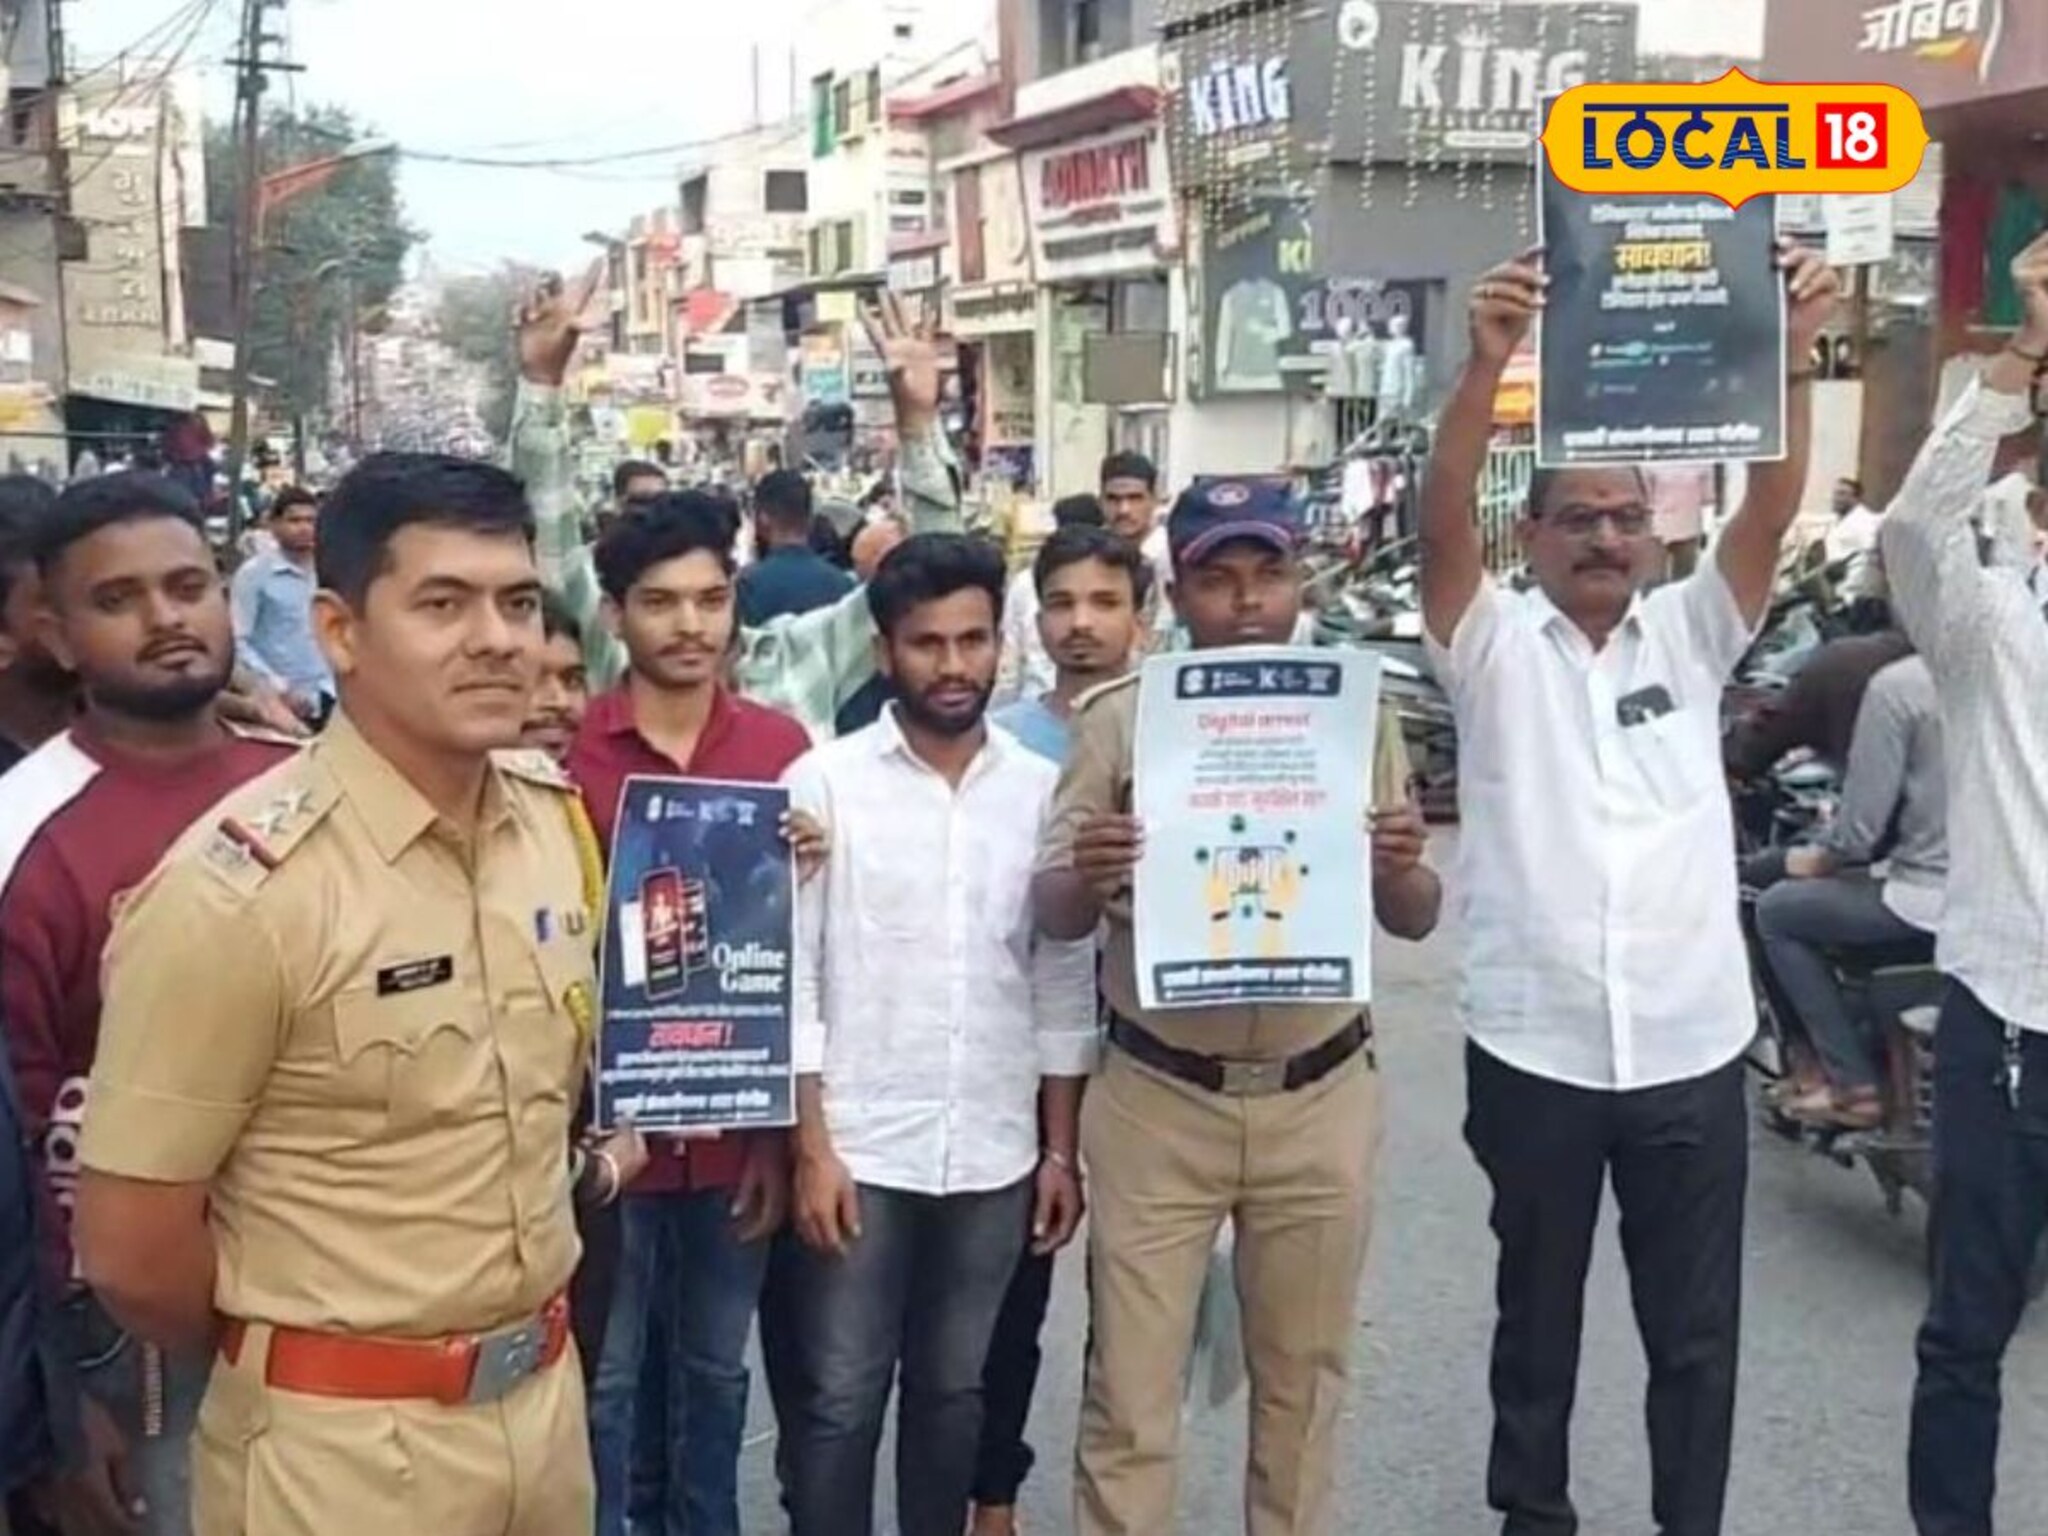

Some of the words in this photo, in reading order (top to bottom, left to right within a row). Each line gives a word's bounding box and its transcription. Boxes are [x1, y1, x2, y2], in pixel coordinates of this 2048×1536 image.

[1400, 43, 1588, 111] KING
[1190, 60, 1290, 135] KING
[1198, 713, 1256, 733] Digital
[1257, 711, 1310, 728] arrest
[712, 942, 786, 974] Online
[720, 970, 784, 993] Game
